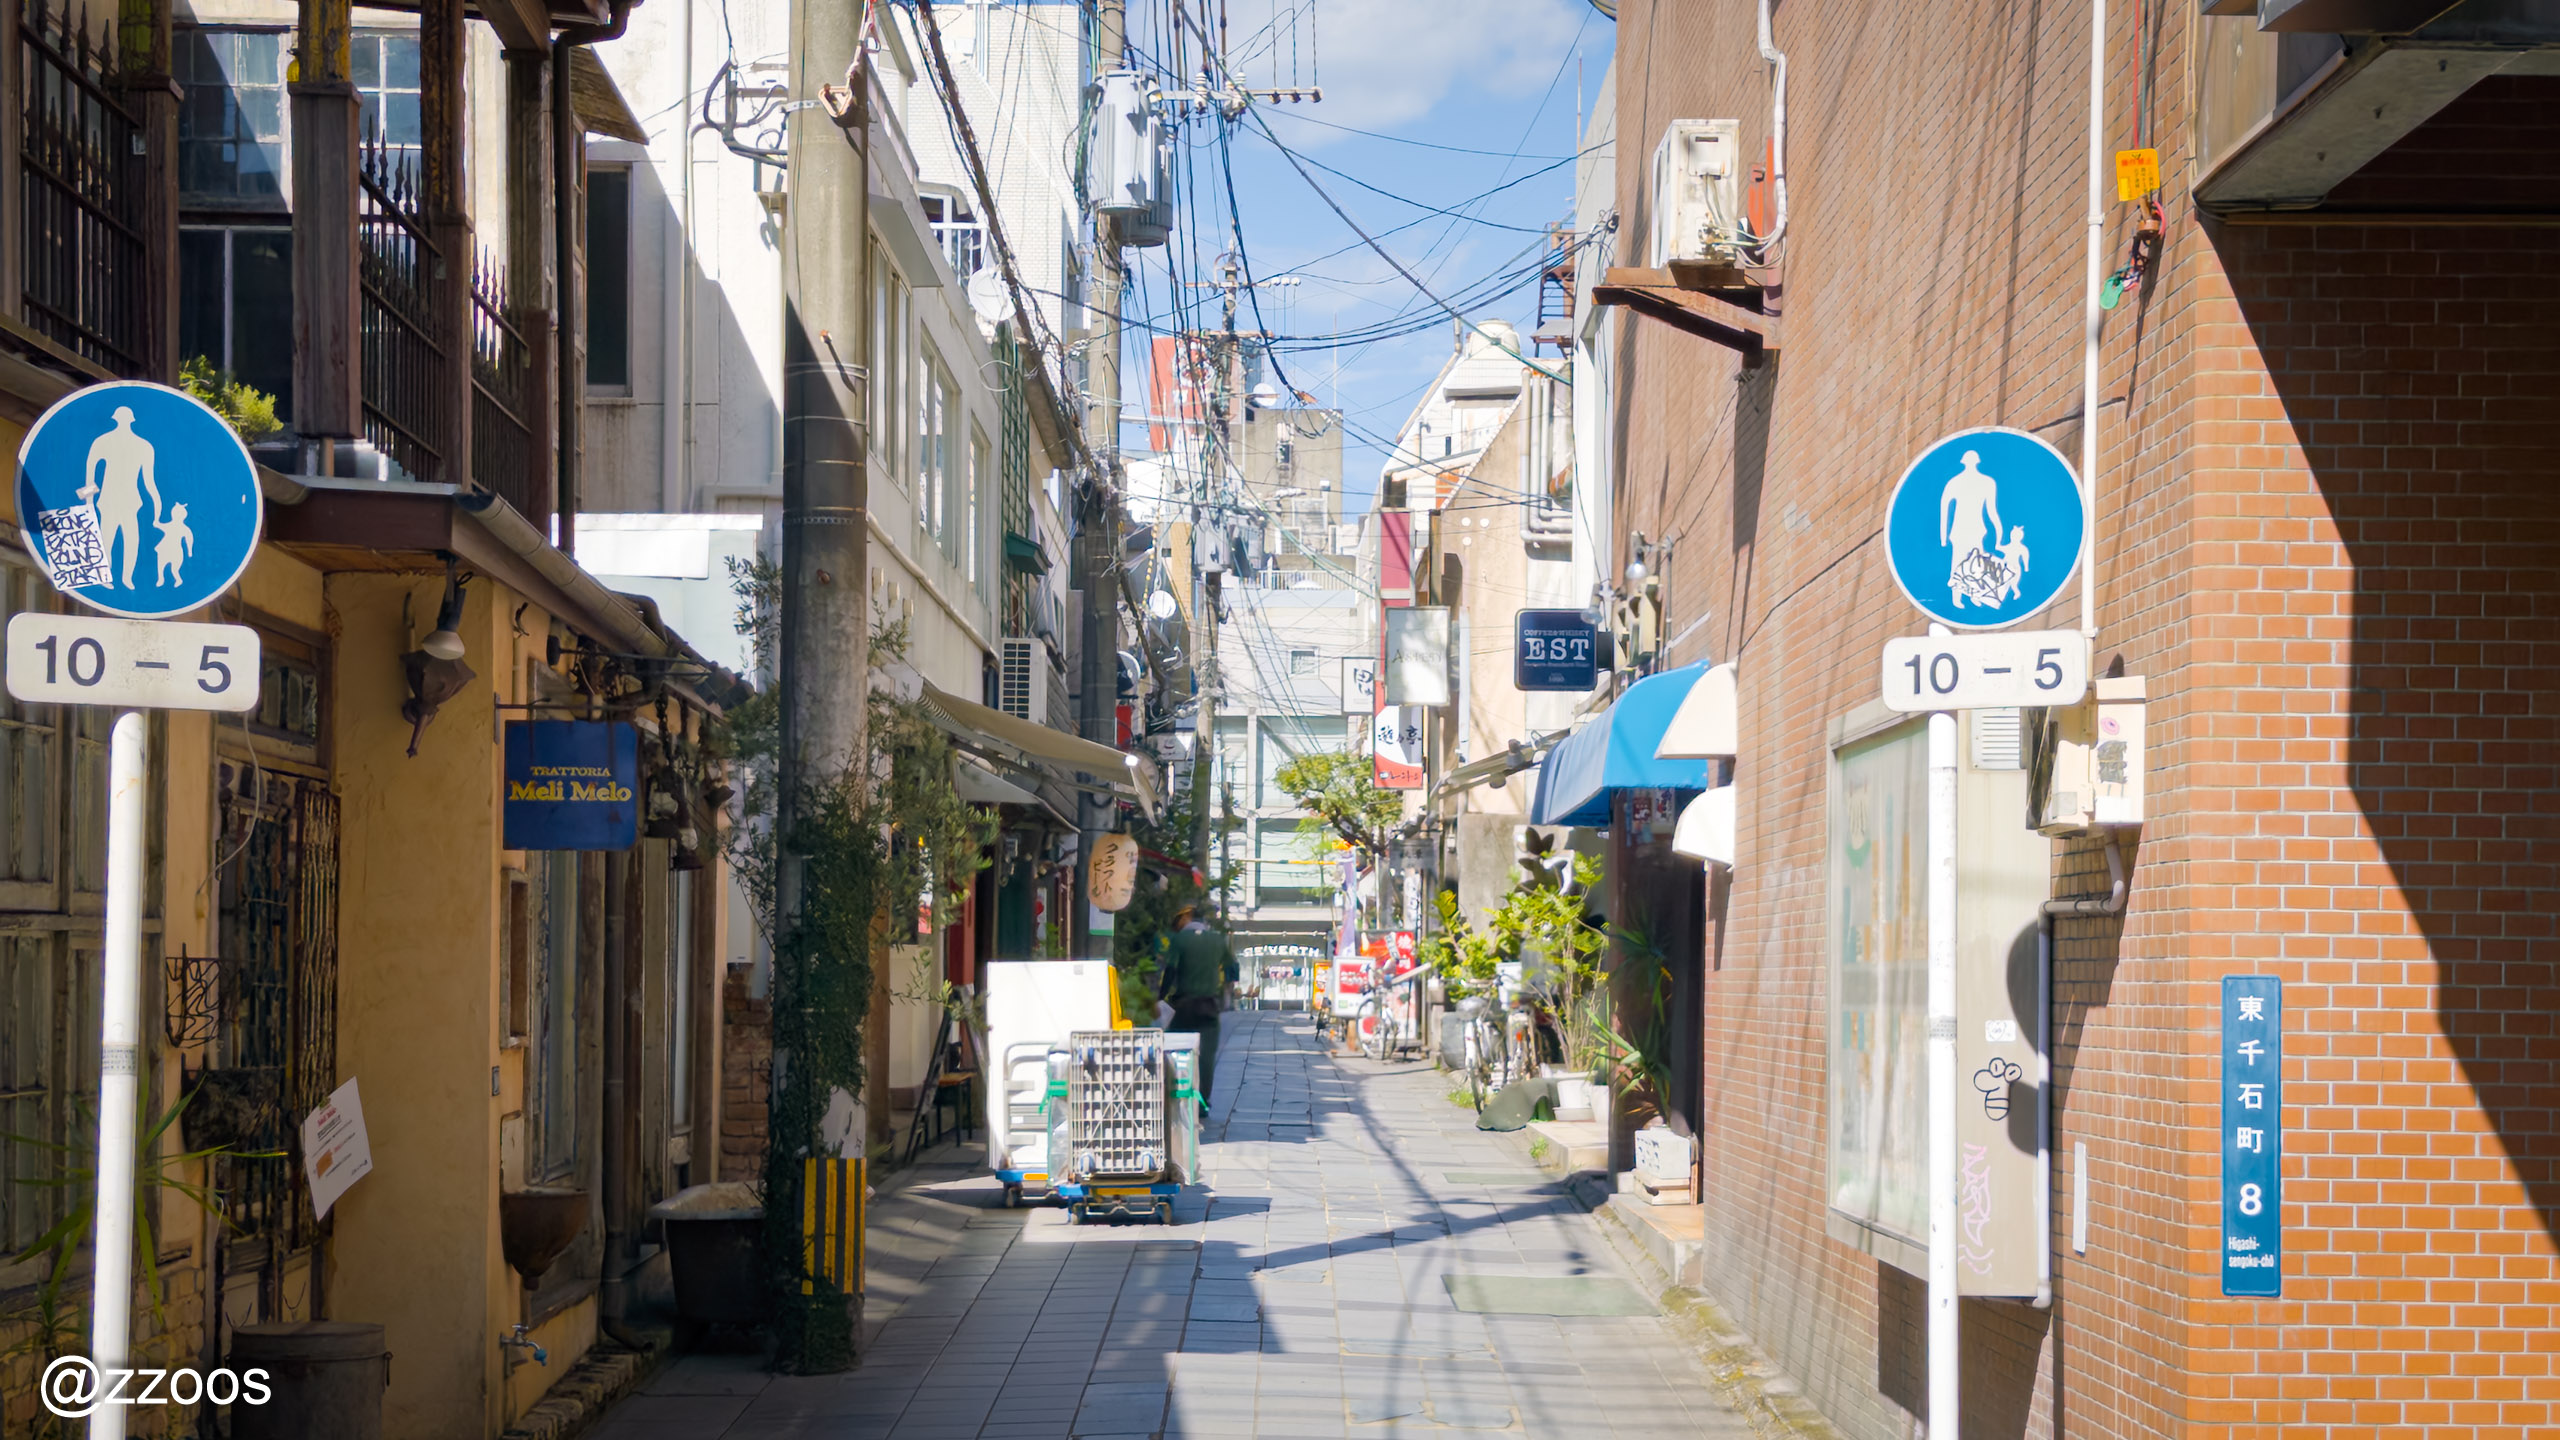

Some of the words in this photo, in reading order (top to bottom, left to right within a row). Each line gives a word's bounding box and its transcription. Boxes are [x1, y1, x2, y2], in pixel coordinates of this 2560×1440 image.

[1524, 637, 1589, 661] EST
[36, 635, 105, 687] 10
[197, 645, 231, 694] 5
[1904, 653, 1959, 695] 10
[2034, 648, 2063, 690] 5
[530, 766, 611, 777] TRATTORIA
[508, 780, 565, 801] Meli
[569, 781, 632, 802] Melo
